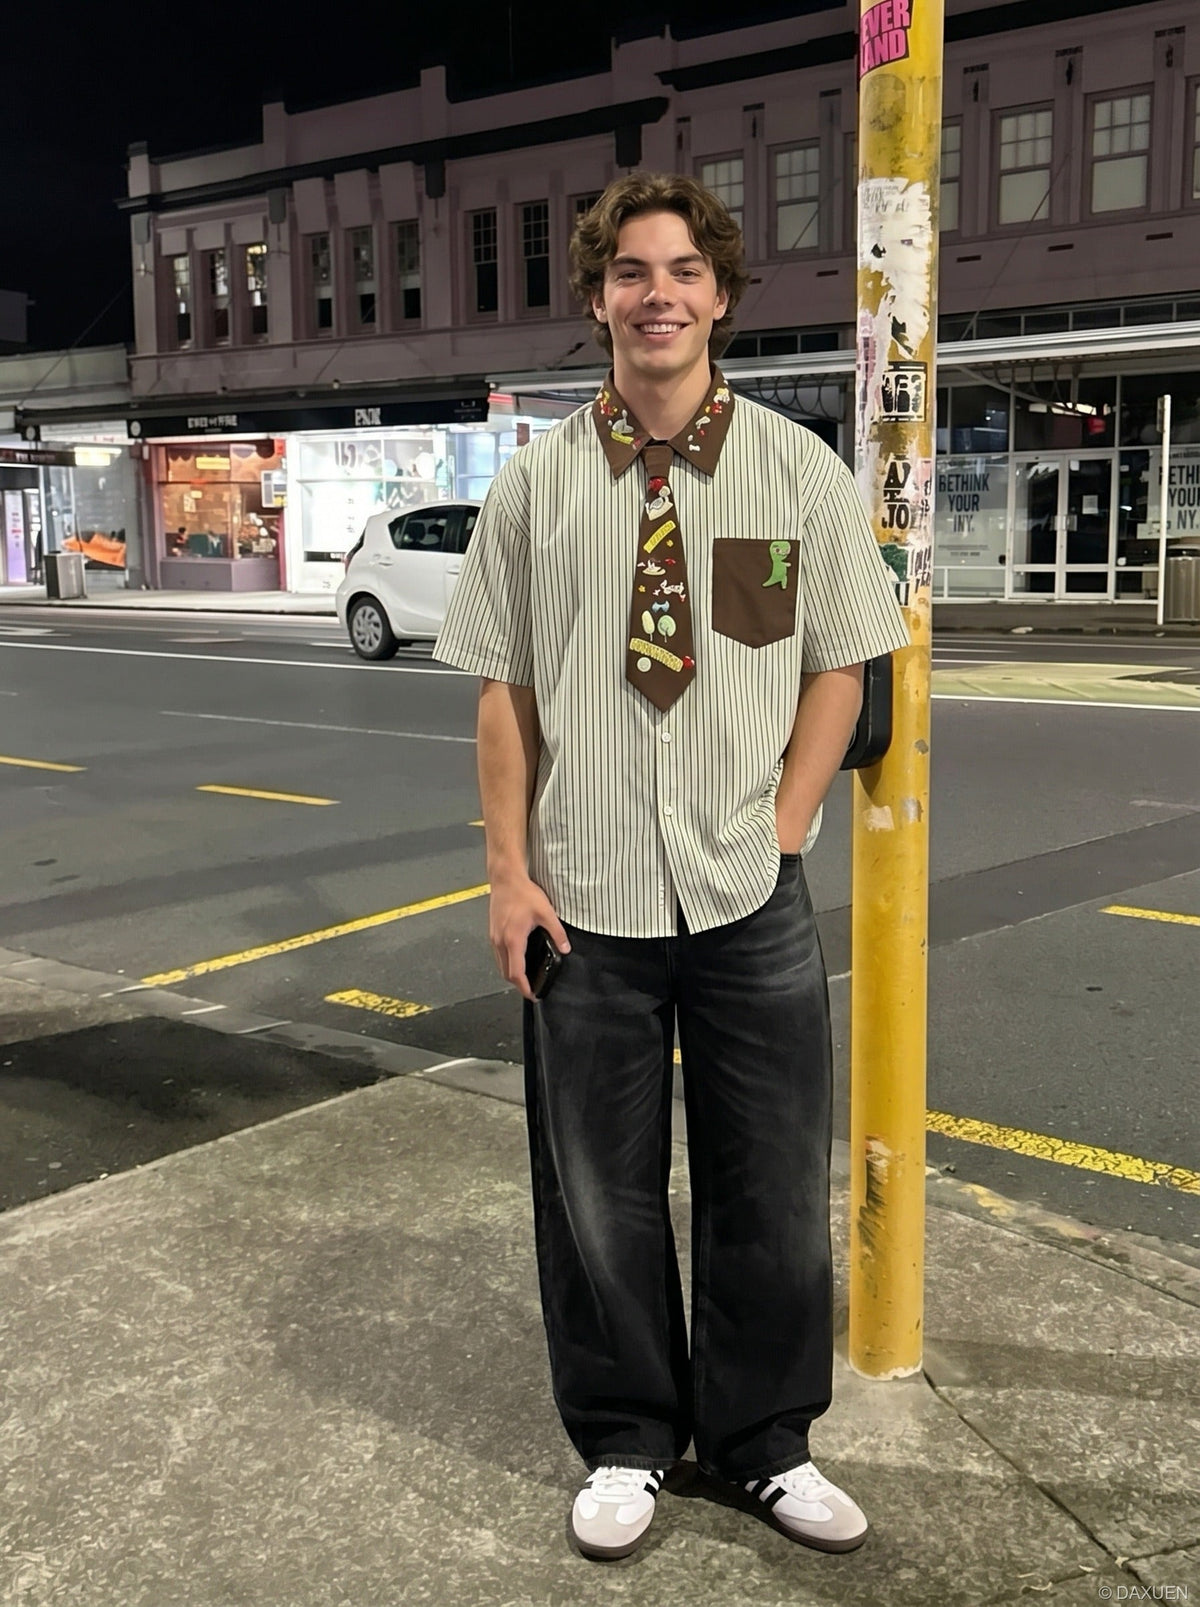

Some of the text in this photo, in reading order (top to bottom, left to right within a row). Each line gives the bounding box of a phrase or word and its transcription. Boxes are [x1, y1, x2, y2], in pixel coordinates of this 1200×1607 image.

[861, 0, 911, 45] EVER
[860, 28, 906, 77] LAND
[1159, 465, 1200, 486] ETHI
[948, 493, 980, 512] YOUR
